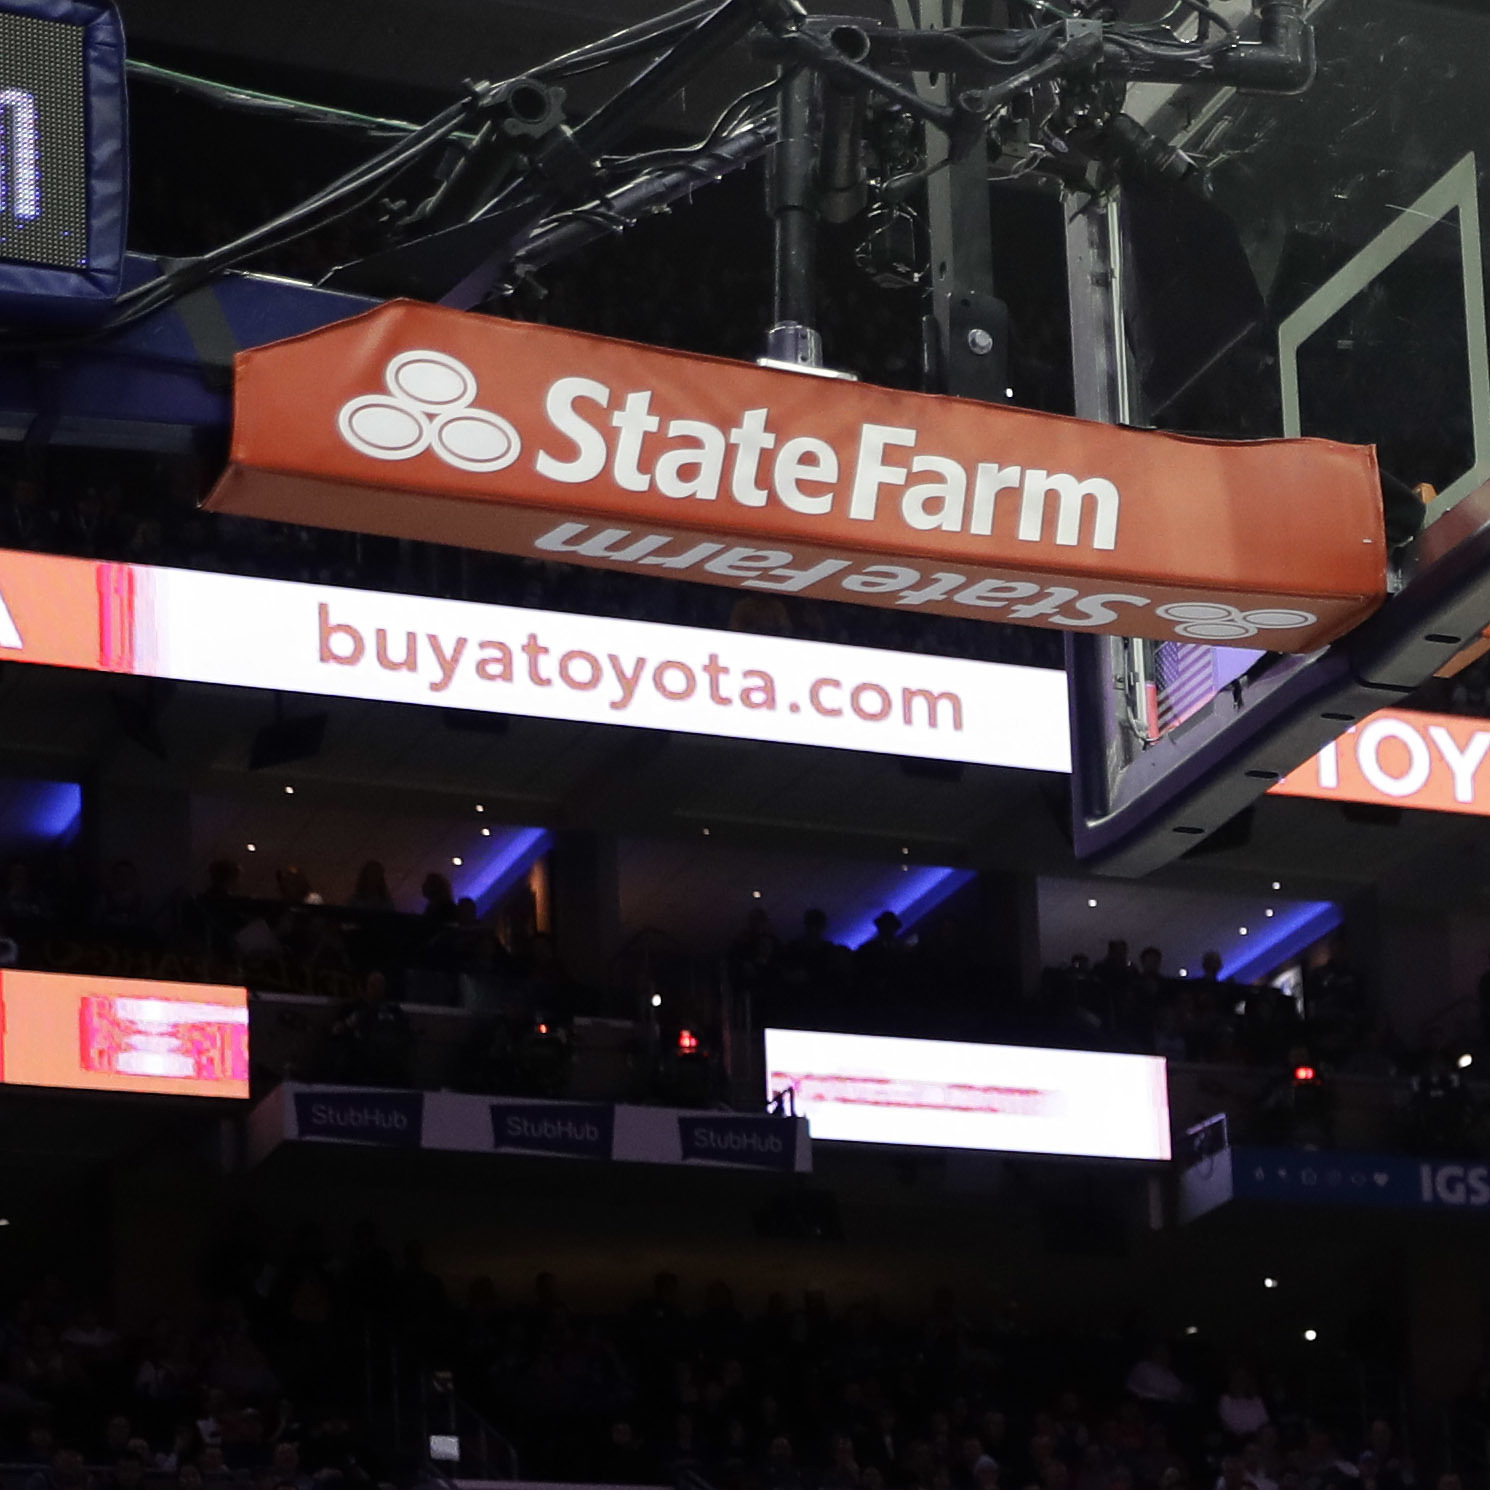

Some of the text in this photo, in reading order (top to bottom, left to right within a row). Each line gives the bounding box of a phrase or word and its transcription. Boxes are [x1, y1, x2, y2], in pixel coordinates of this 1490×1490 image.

[318, 602, 966, 732] buyatoyota.com
[310, 1103, 409, 1131] StubHub
[506, 1113, 600, 1142] StubHub
[692, 1126, 784, 1154] StubHub
